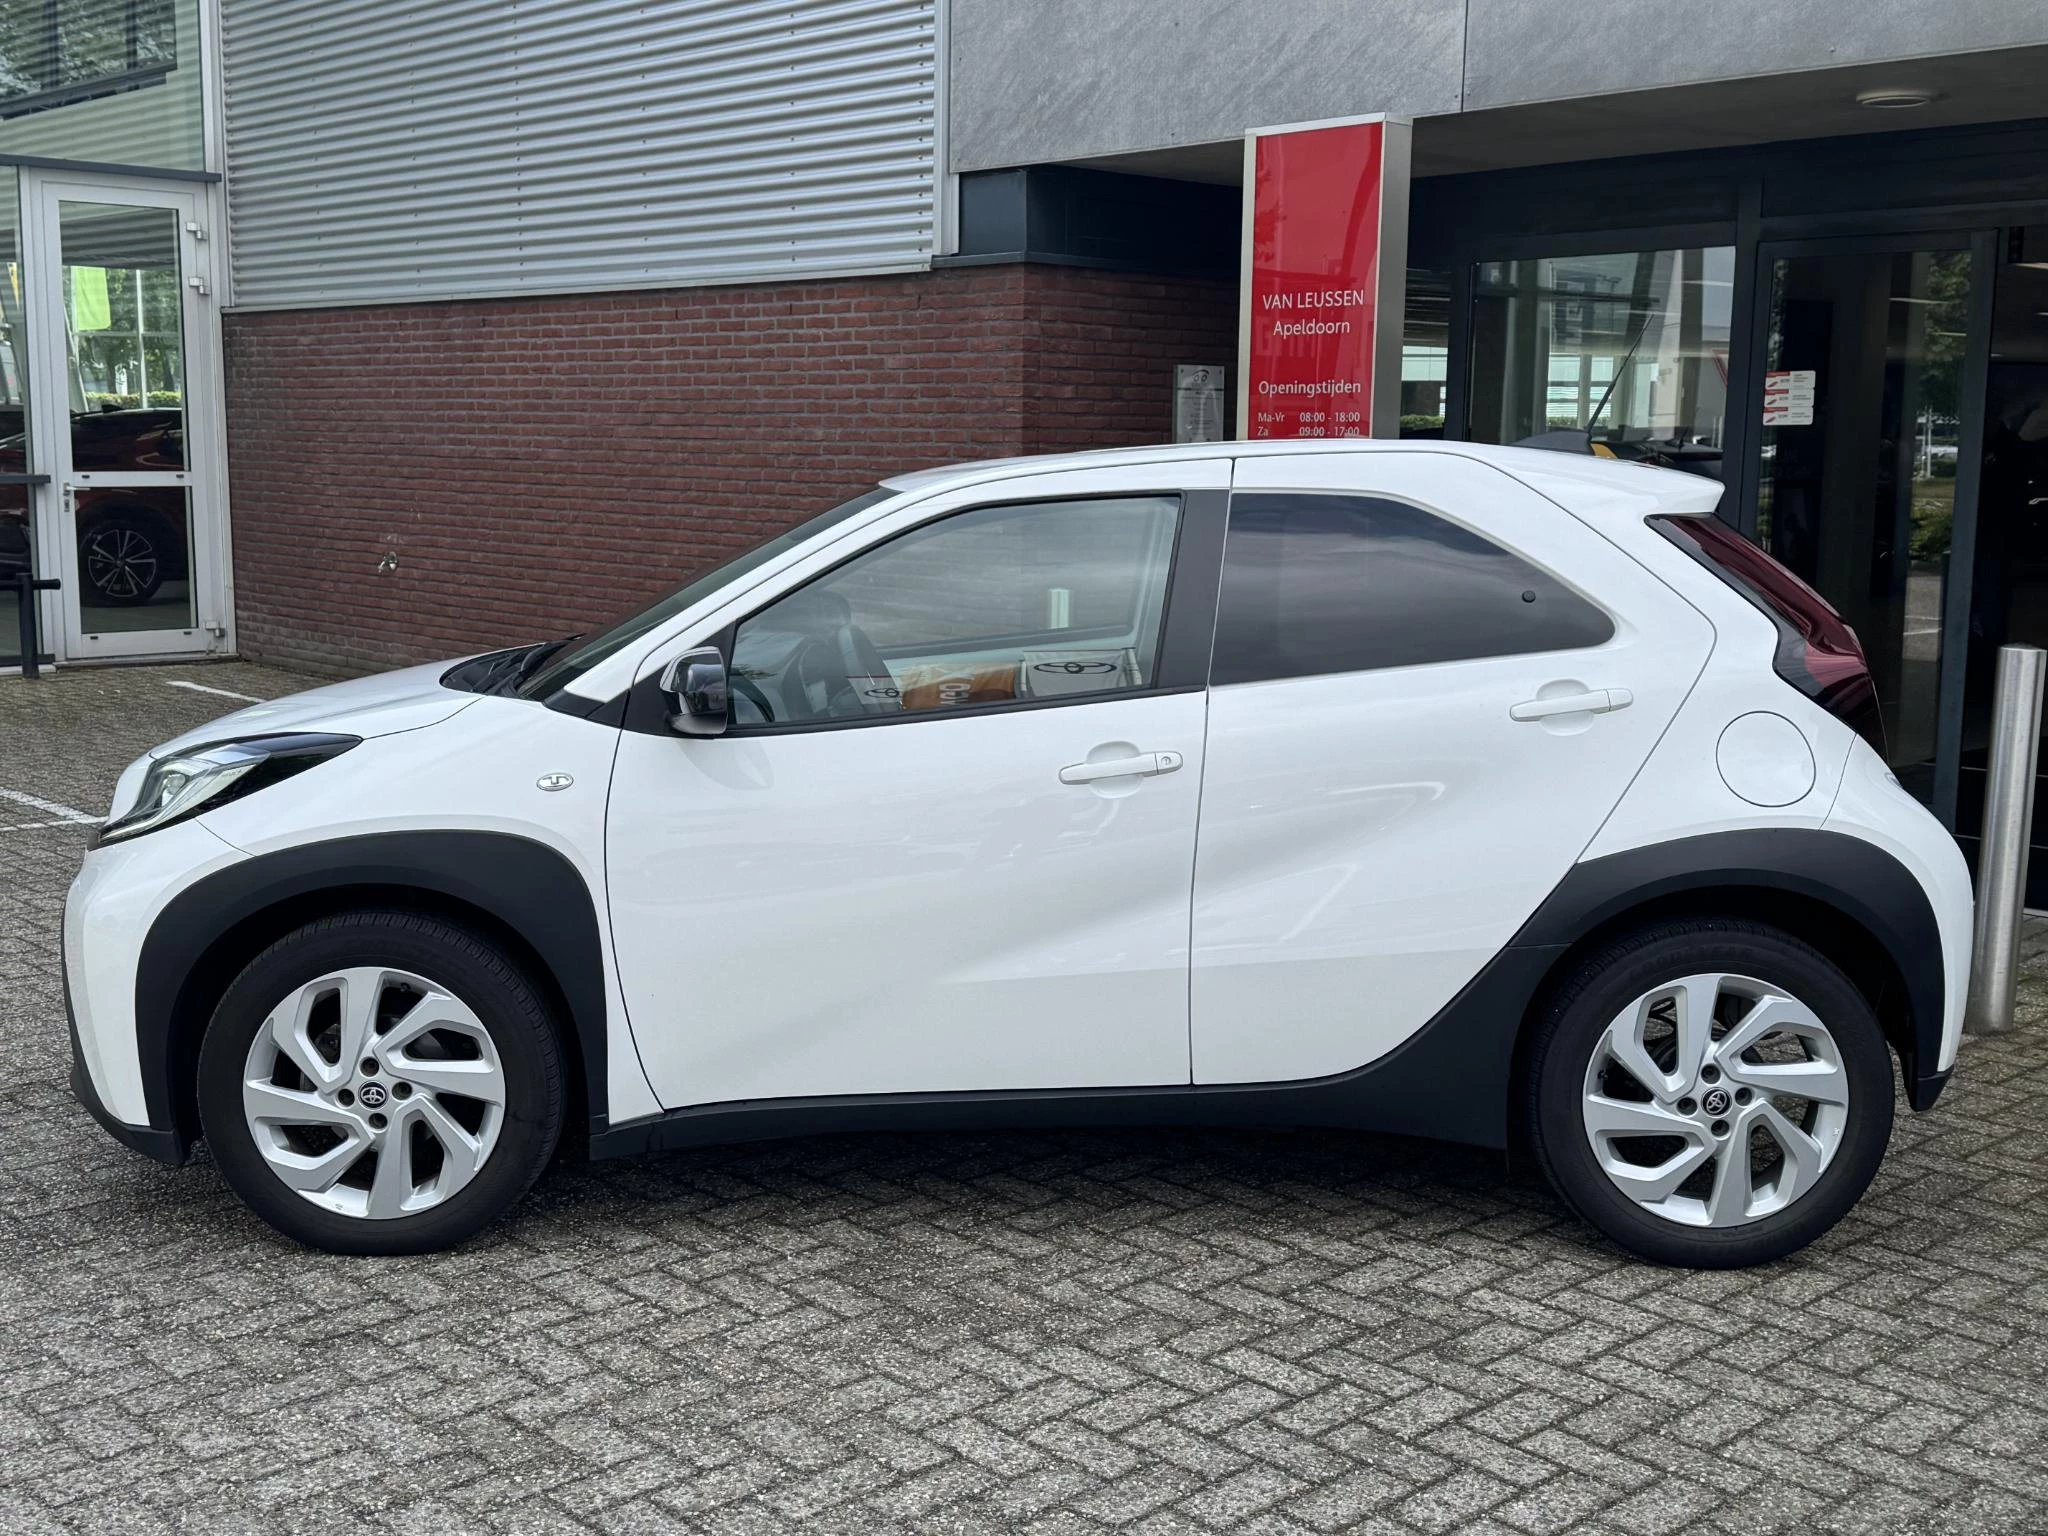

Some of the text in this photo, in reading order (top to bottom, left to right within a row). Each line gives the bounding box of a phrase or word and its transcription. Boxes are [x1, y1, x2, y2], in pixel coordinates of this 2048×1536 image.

[1262, 289, 1364, 310] VAN LEUSSEN
[1272, 318, 1350, 339] Apeldoorn
[1258, 379, 1361, 398] Openingstijden
[1257, 411, 1285, 422] Ma-Vr
[1299, 411, 1325, 422] 08:00
[1335, 411, 1360, 422] 18:00
[1256, 426, 1269, 436] Za
[1299, 426, 1325, 437] 09:00
[1334, 425, 1360, 437] 17:00
